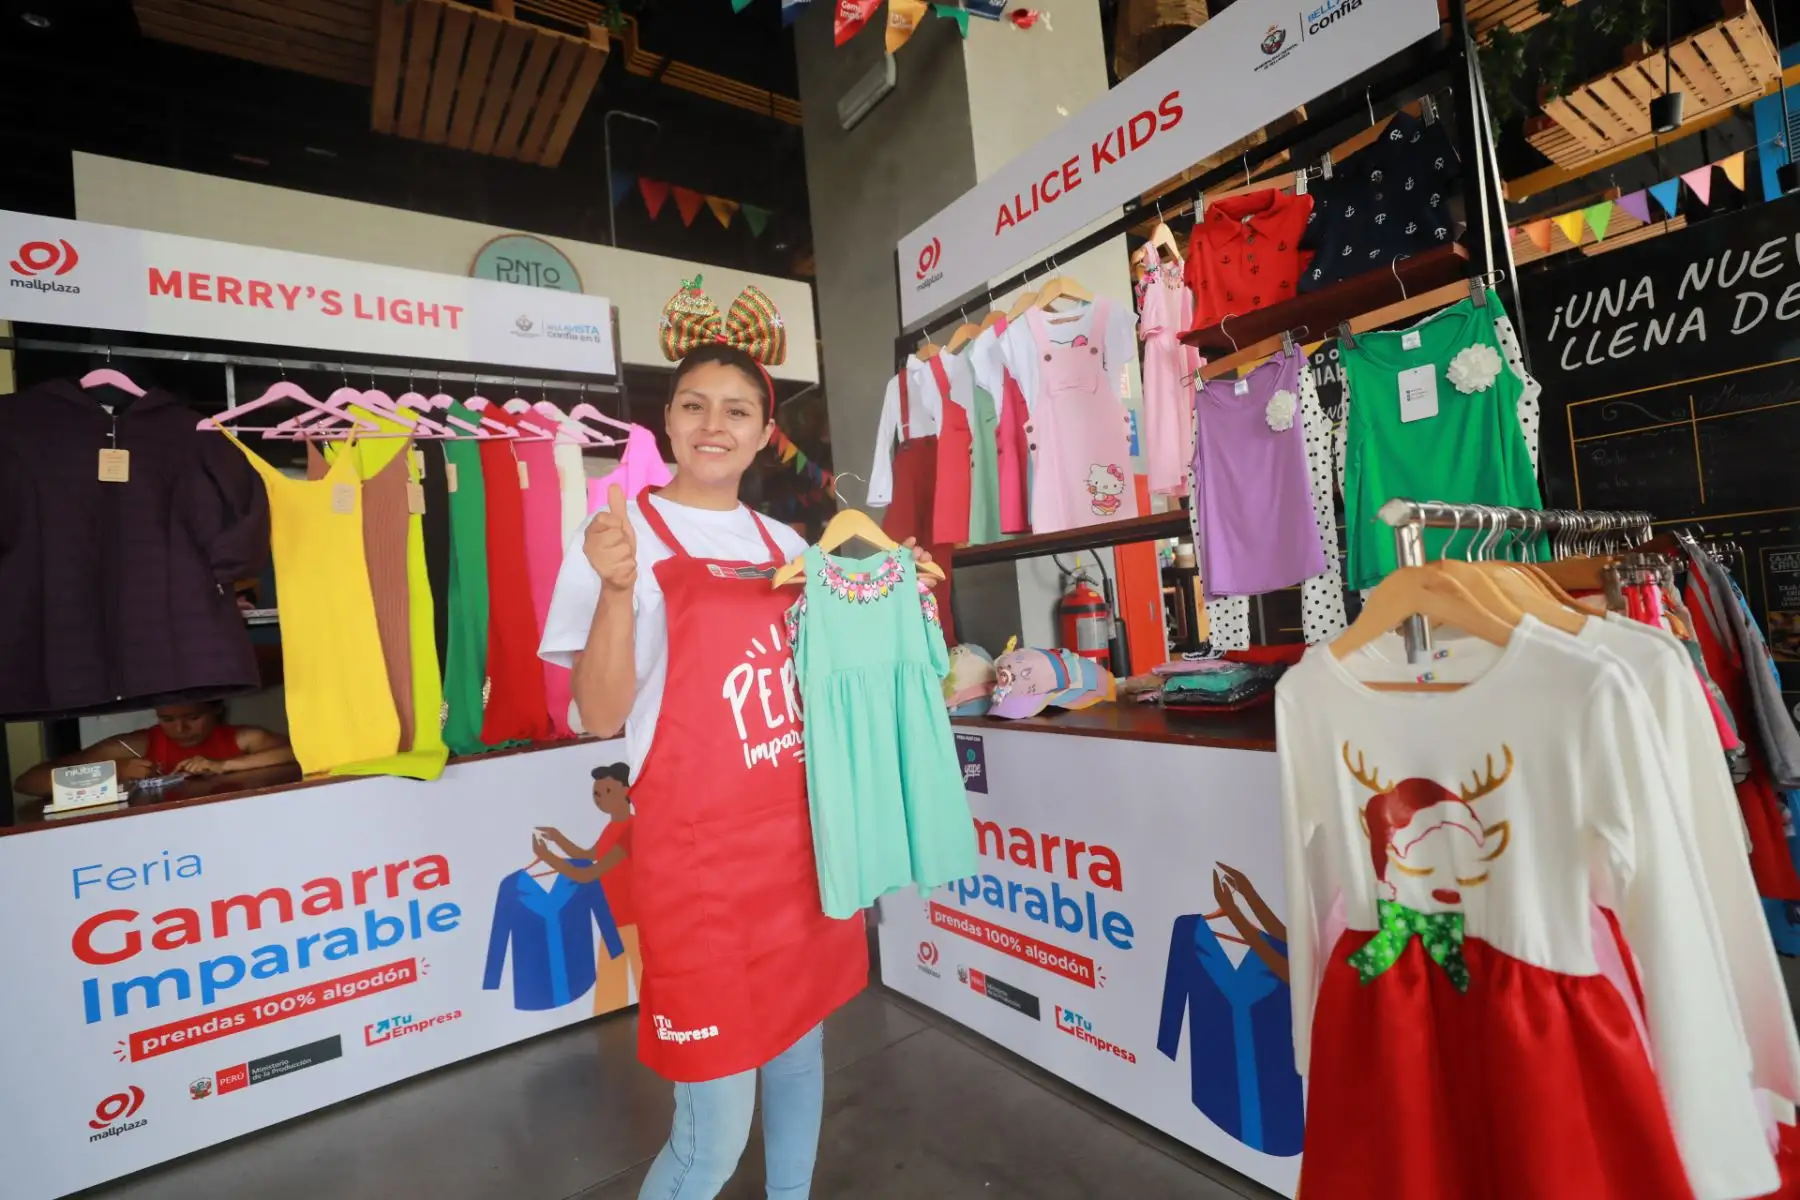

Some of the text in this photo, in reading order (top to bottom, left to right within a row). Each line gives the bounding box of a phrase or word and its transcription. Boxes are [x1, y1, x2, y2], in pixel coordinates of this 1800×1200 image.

[1308, 0, 1340, 22] BELL
[994, 90, 1184, 236] ALICE KIDS
[9, 278, 81, 294] mallplaza
[148, 267, 464, 330] MERRY'S LIGHT
[1547, 232, 1800, 342] ¡UNA NUE
[1560, 281, 1800, 371] LLENA DE
[722, 657, 804, 740] PER
[743, 728, 804, 769] Impar
[72, 850, 203, 899] Feria
[973, 817, 1123, 892] marra
[71, 854, 450, 966] Gamarra
[948, 873, 1135, 950] parable
[82, 899, 461, 1025] Imparable
[934, 909, 1089, 979] prendas 100% algodón
[142, 965, 410, 1054] prendas 100% algodón
[391, 1014, 412, 1026] Tu
[392, 1010, 461, 1038] Empresa
[655, 1014, 673, 1029] Tu
[1075, 1014, 1093, 1031] Tu
[658, 1026, 719, 1045] Empresa
[1075, 1027, 1137, 1064] Empresa
[220, 1071, 245, 1086] PERÚ
[251, 1060, 289, 1075] Ministerio
[252, 1073, 262, 1081] de
[89, 1119, 148, 1142] mallplaza
